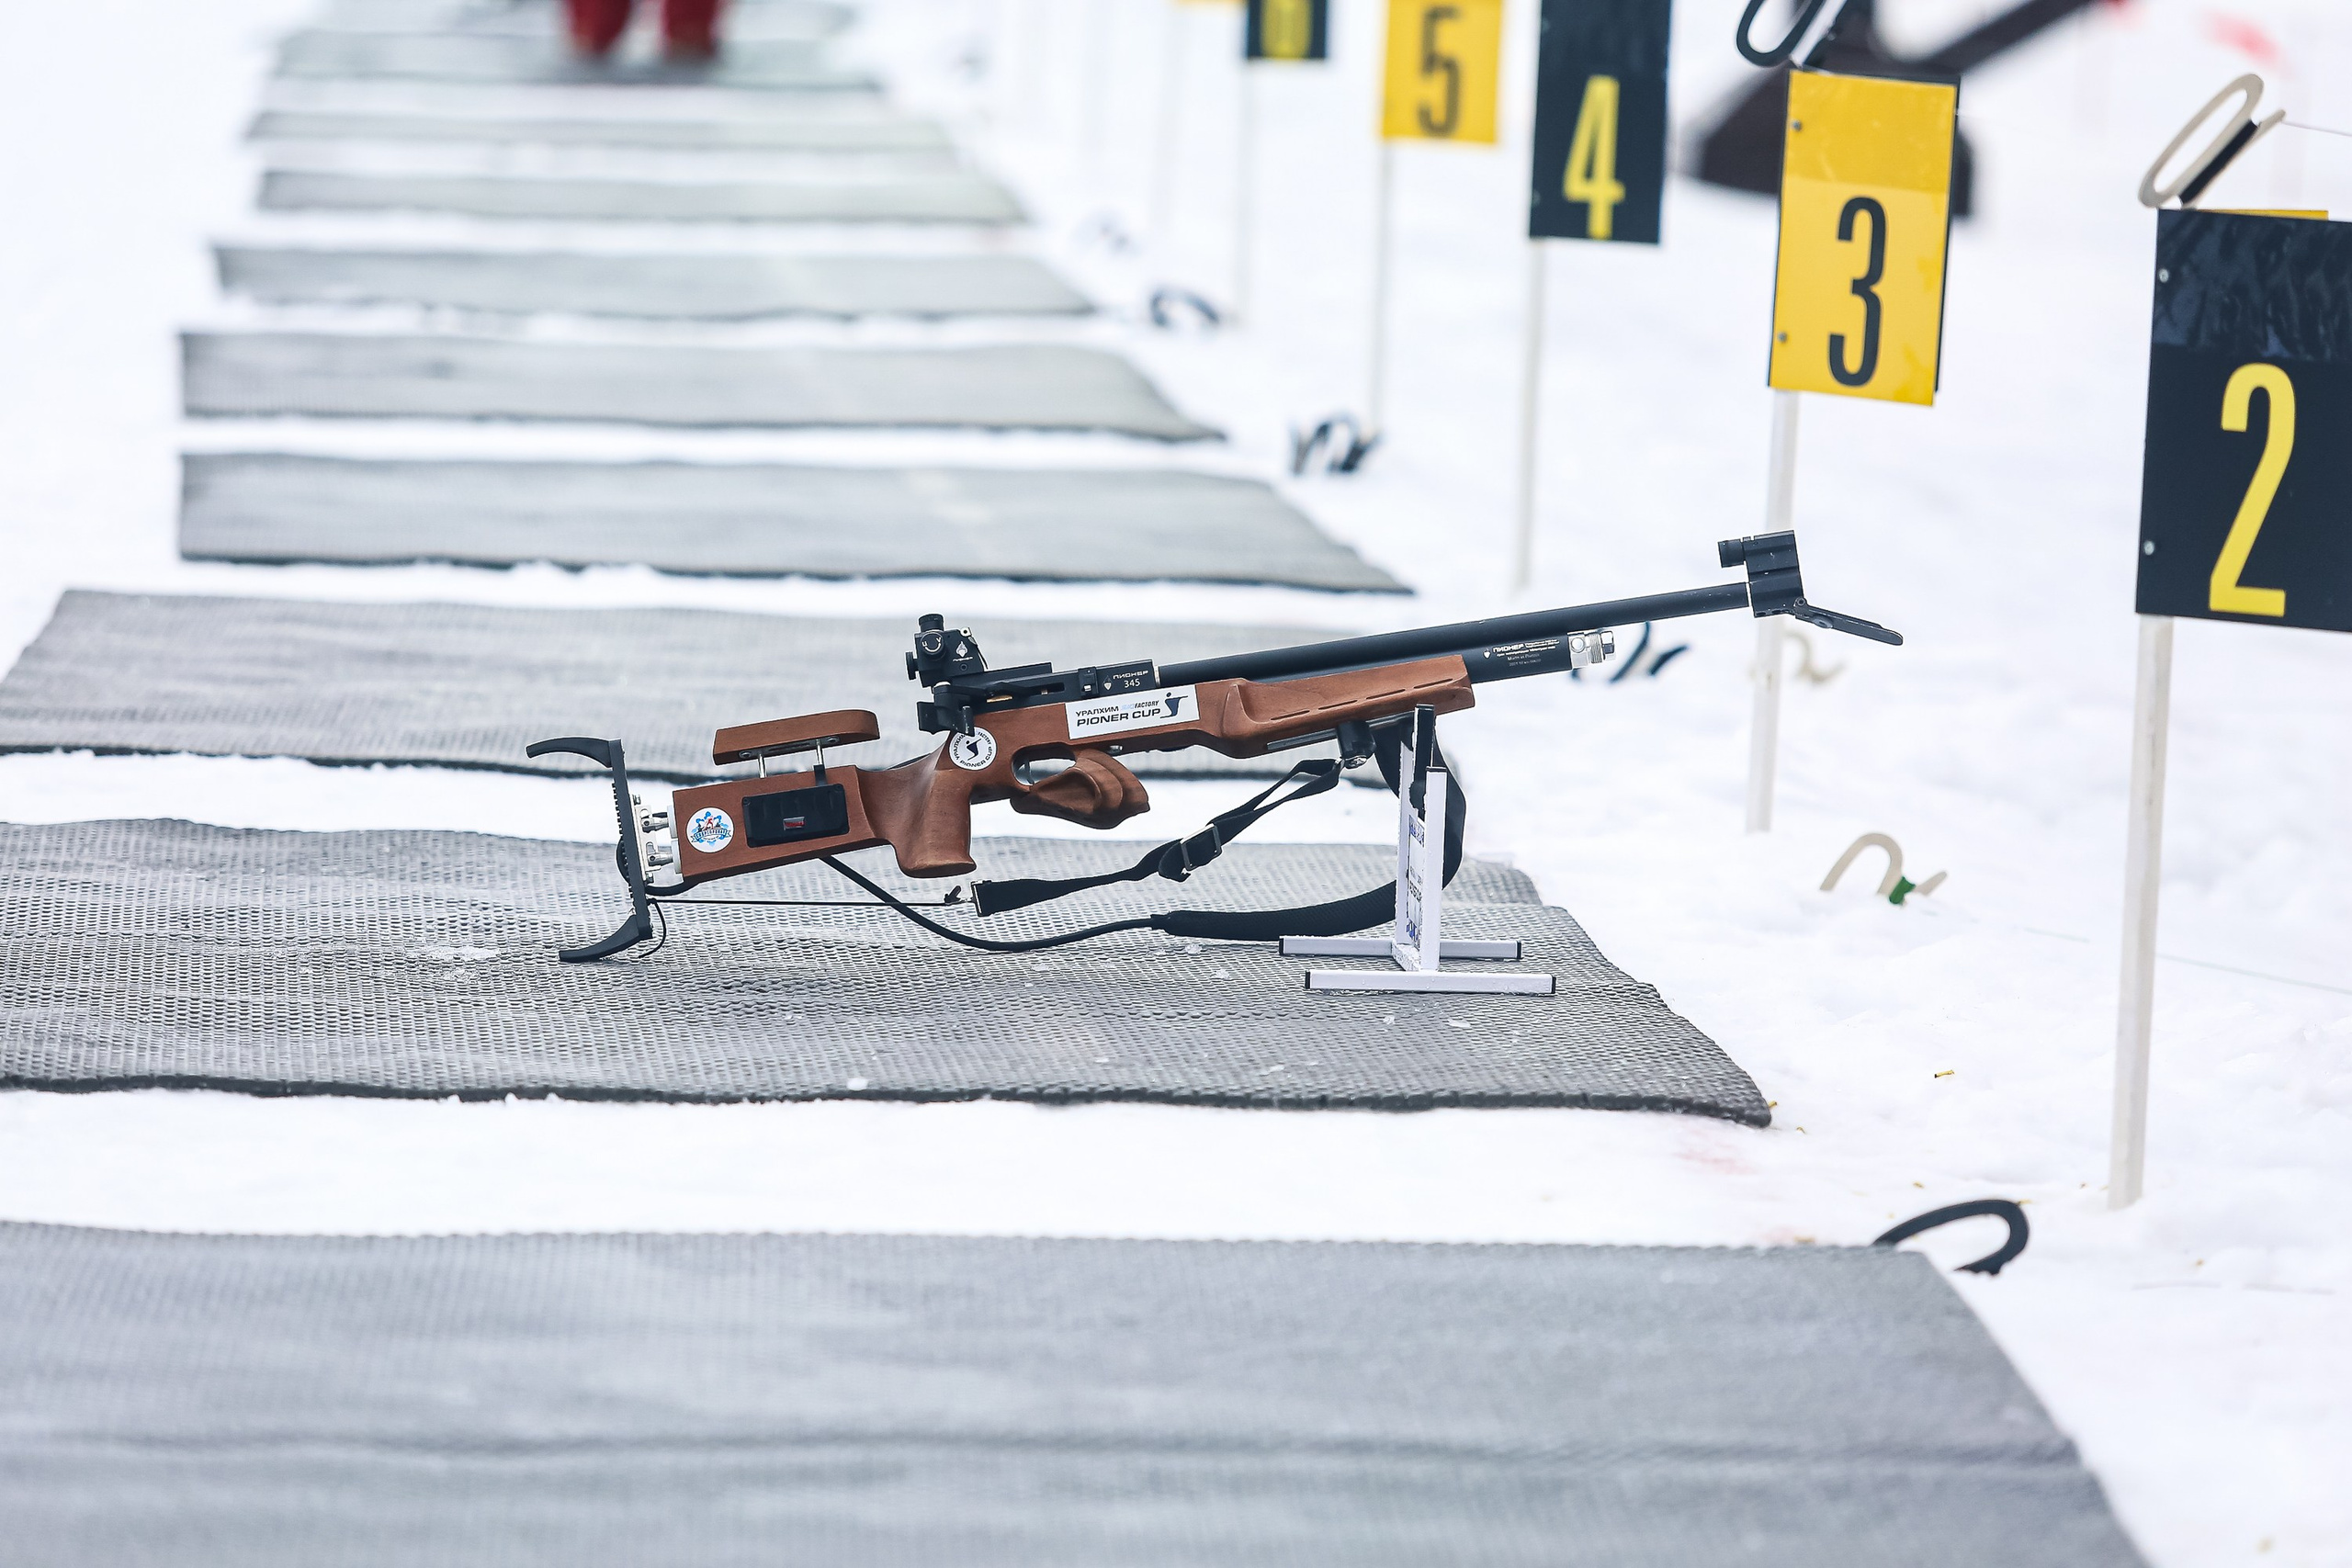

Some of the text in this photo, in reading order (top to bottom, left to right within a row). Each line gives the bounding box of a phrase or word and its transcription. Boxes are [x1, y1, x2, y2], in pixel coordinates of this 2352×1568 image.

[1417, 6, 1461, 139] 5
[1564, 74, 1625, 240] 4
[1827, 197, 1888, 388] 3
[2209, 362, 2296, 617] 2
[1075, 705, 1119, 716] УРАЛХИМ
[1134, 700, 1159, 709] FACTORY
[1113, 670, 1148, 680] ПИОНЕР
[1124, 678, 1141, 689] 345
[1077, 708, 1161, 728] PIONER CUP
